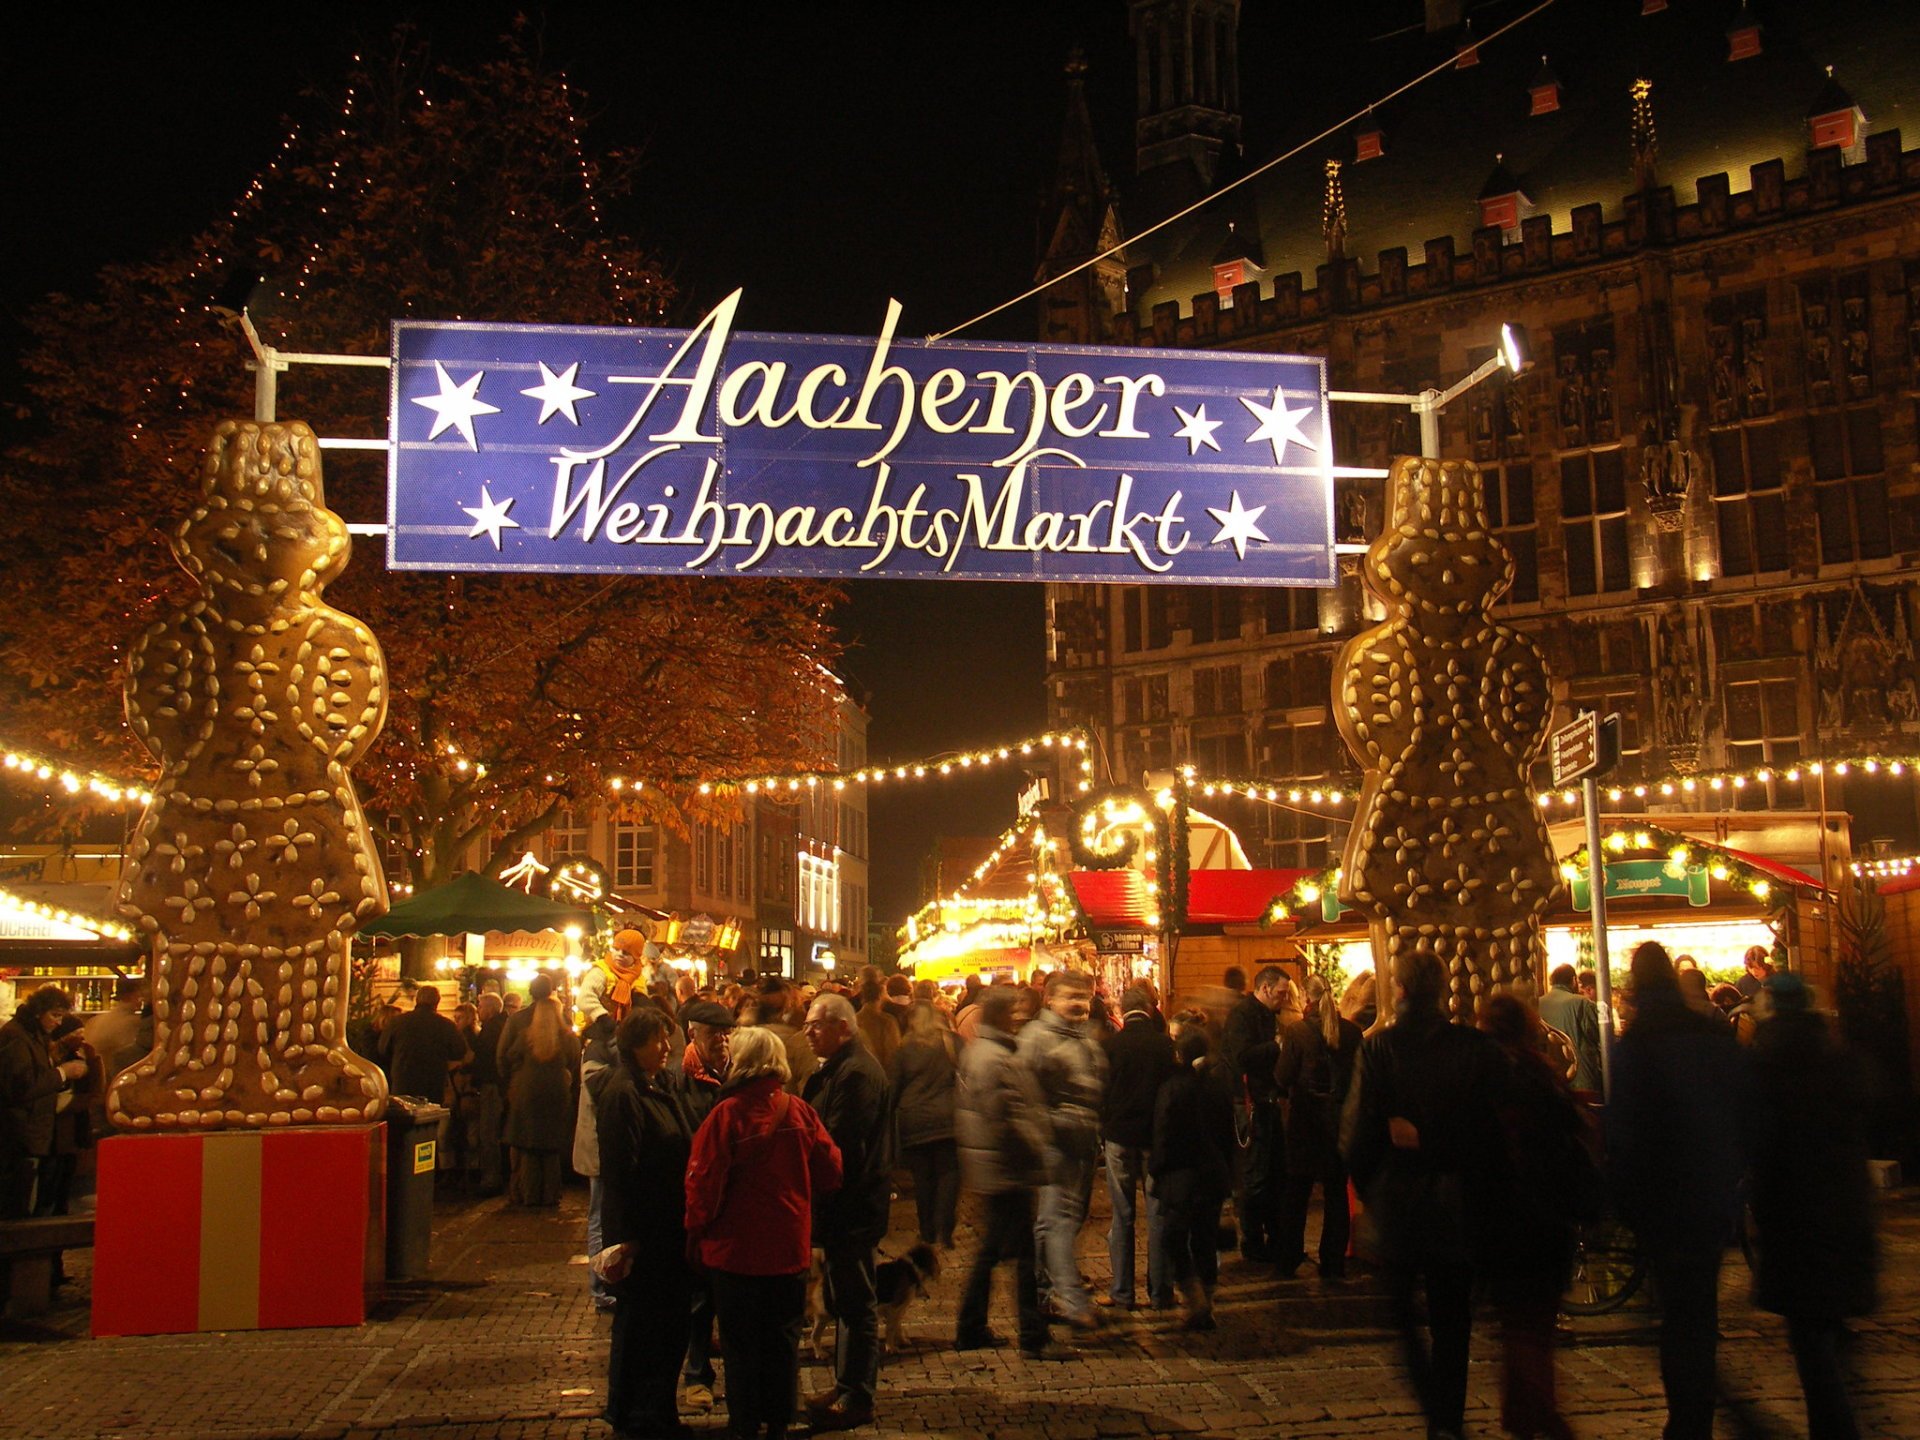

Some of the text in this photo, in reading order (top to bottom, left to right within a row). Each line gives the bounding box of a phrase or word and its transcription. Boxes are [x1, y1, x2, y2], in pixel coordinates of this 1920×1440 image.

[560, 287, 1165, 467] Aachener
[495, 933, 560, 952] Maroni
[1114, 933, 1142, 941] blumen
